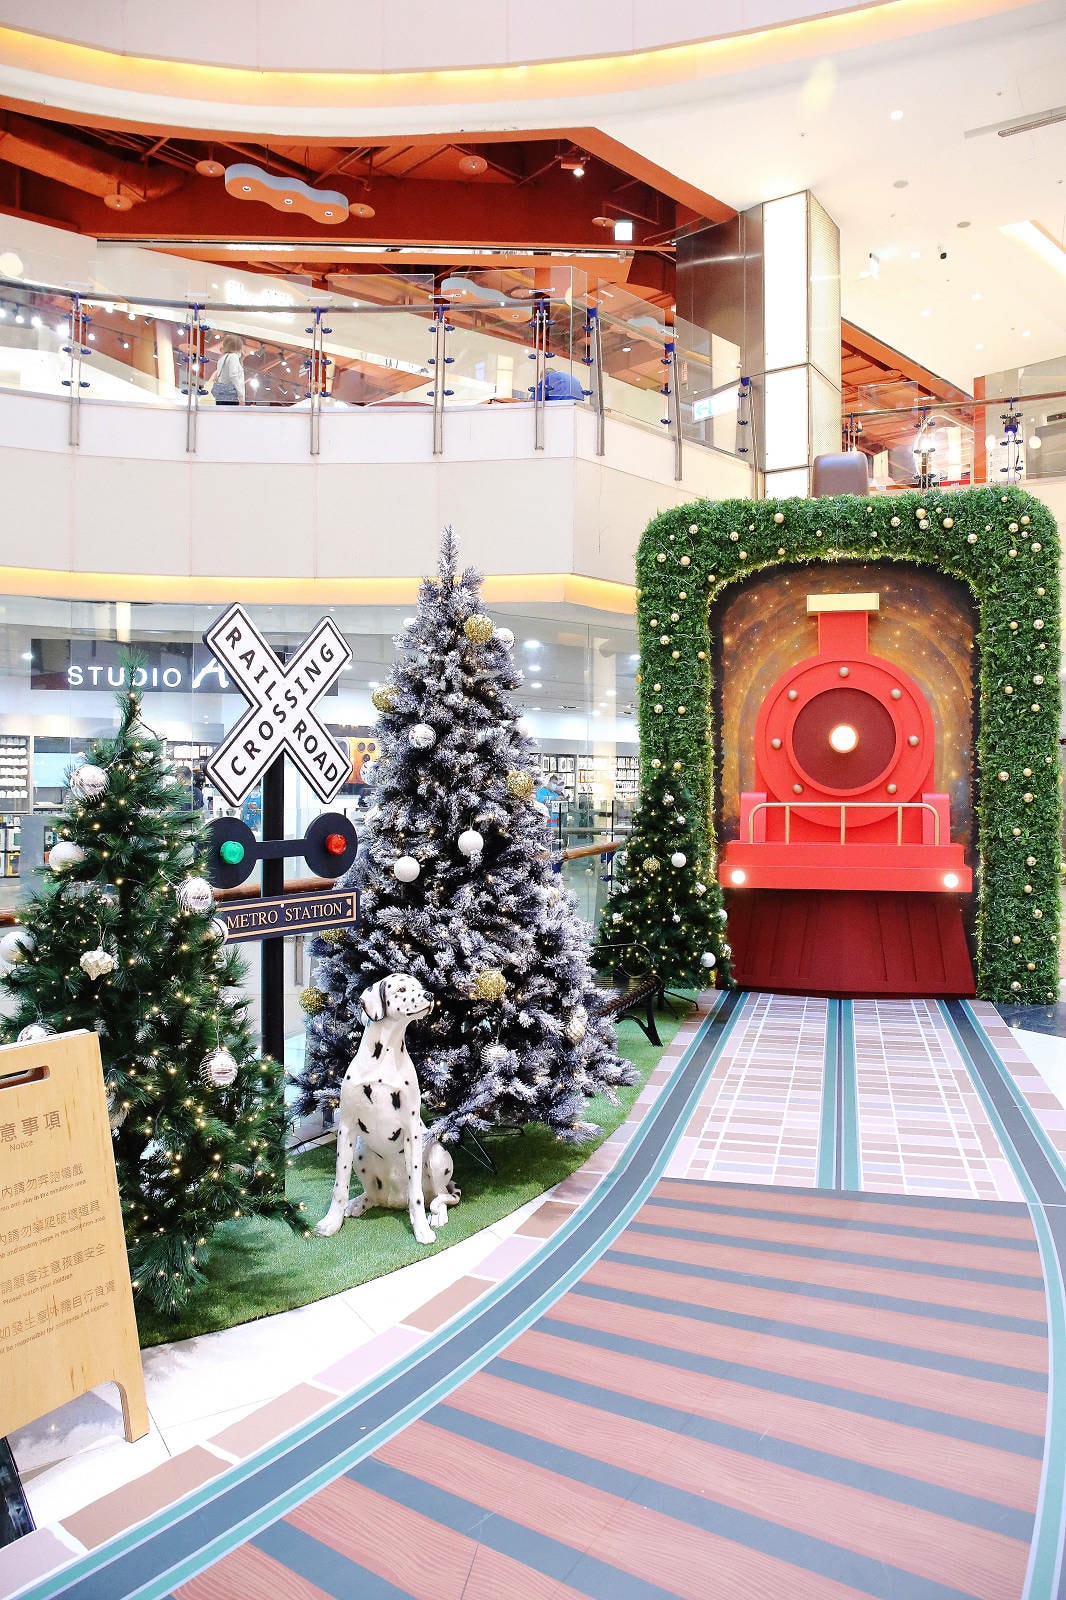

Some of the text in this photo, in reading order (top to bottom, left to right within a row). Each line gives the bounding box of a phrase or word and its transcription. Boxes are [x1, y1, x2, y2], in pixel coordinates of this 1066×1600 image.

[67, 665, 182, 688] STUDIO
[225, 626, 277, 701] RAIL
[230, 643, 335, 777] CROSSING
[292, 719, 338, 783] ROAD
[227, 902, 343, 930] METRO STATION
[9, 1140, 34, 1152] Notice
